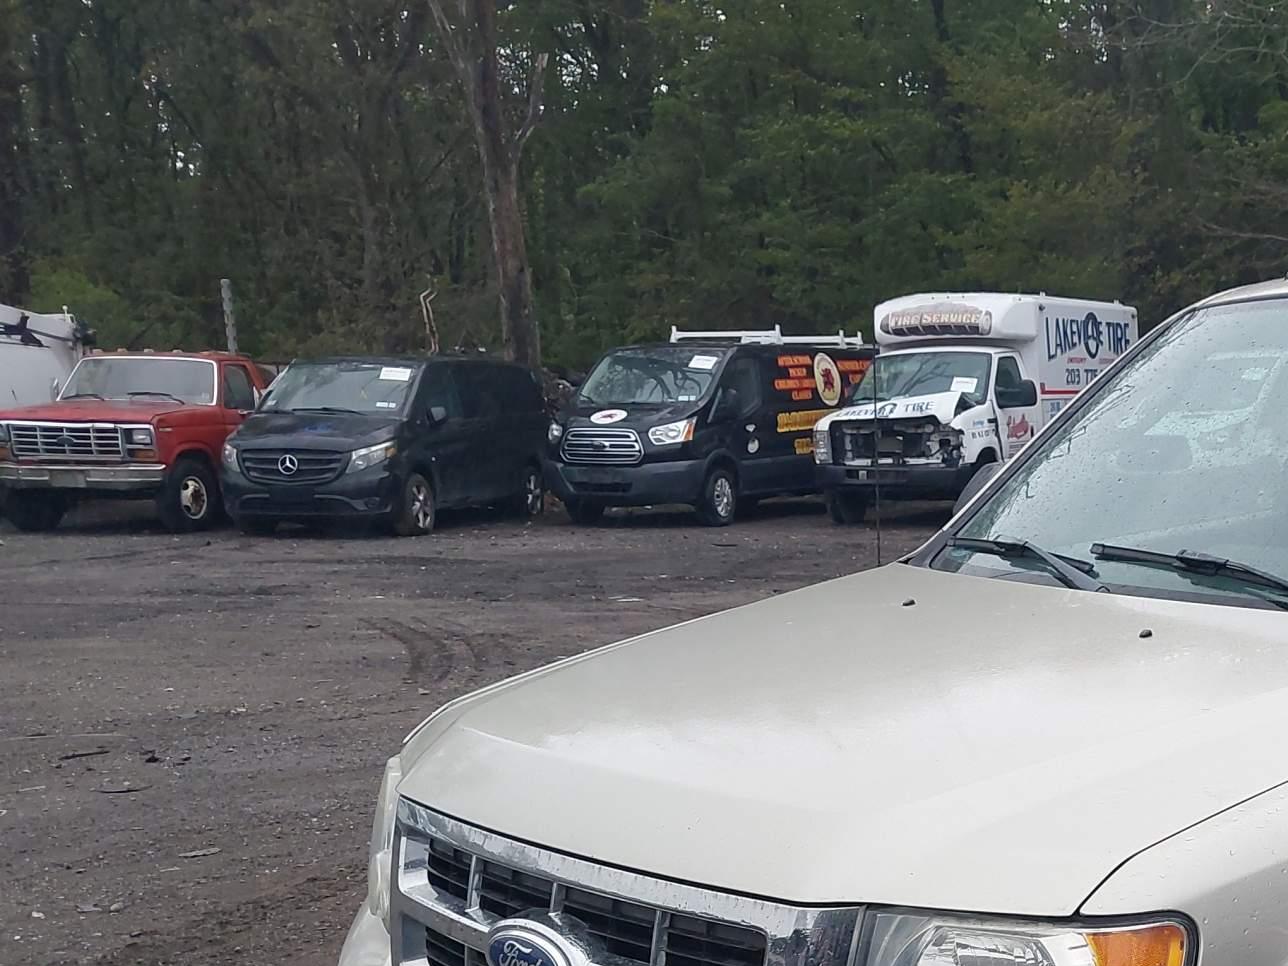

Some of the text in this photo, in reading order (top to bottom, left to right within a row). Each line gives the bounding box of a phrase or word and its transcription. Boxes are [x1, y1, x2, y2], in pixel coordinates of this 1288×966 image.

[921, 311, 981, 325] SERVICE
[1045, 316, 1130, 362] LAKEVE TIRE
[1065, 368, 1081, 386] 203
